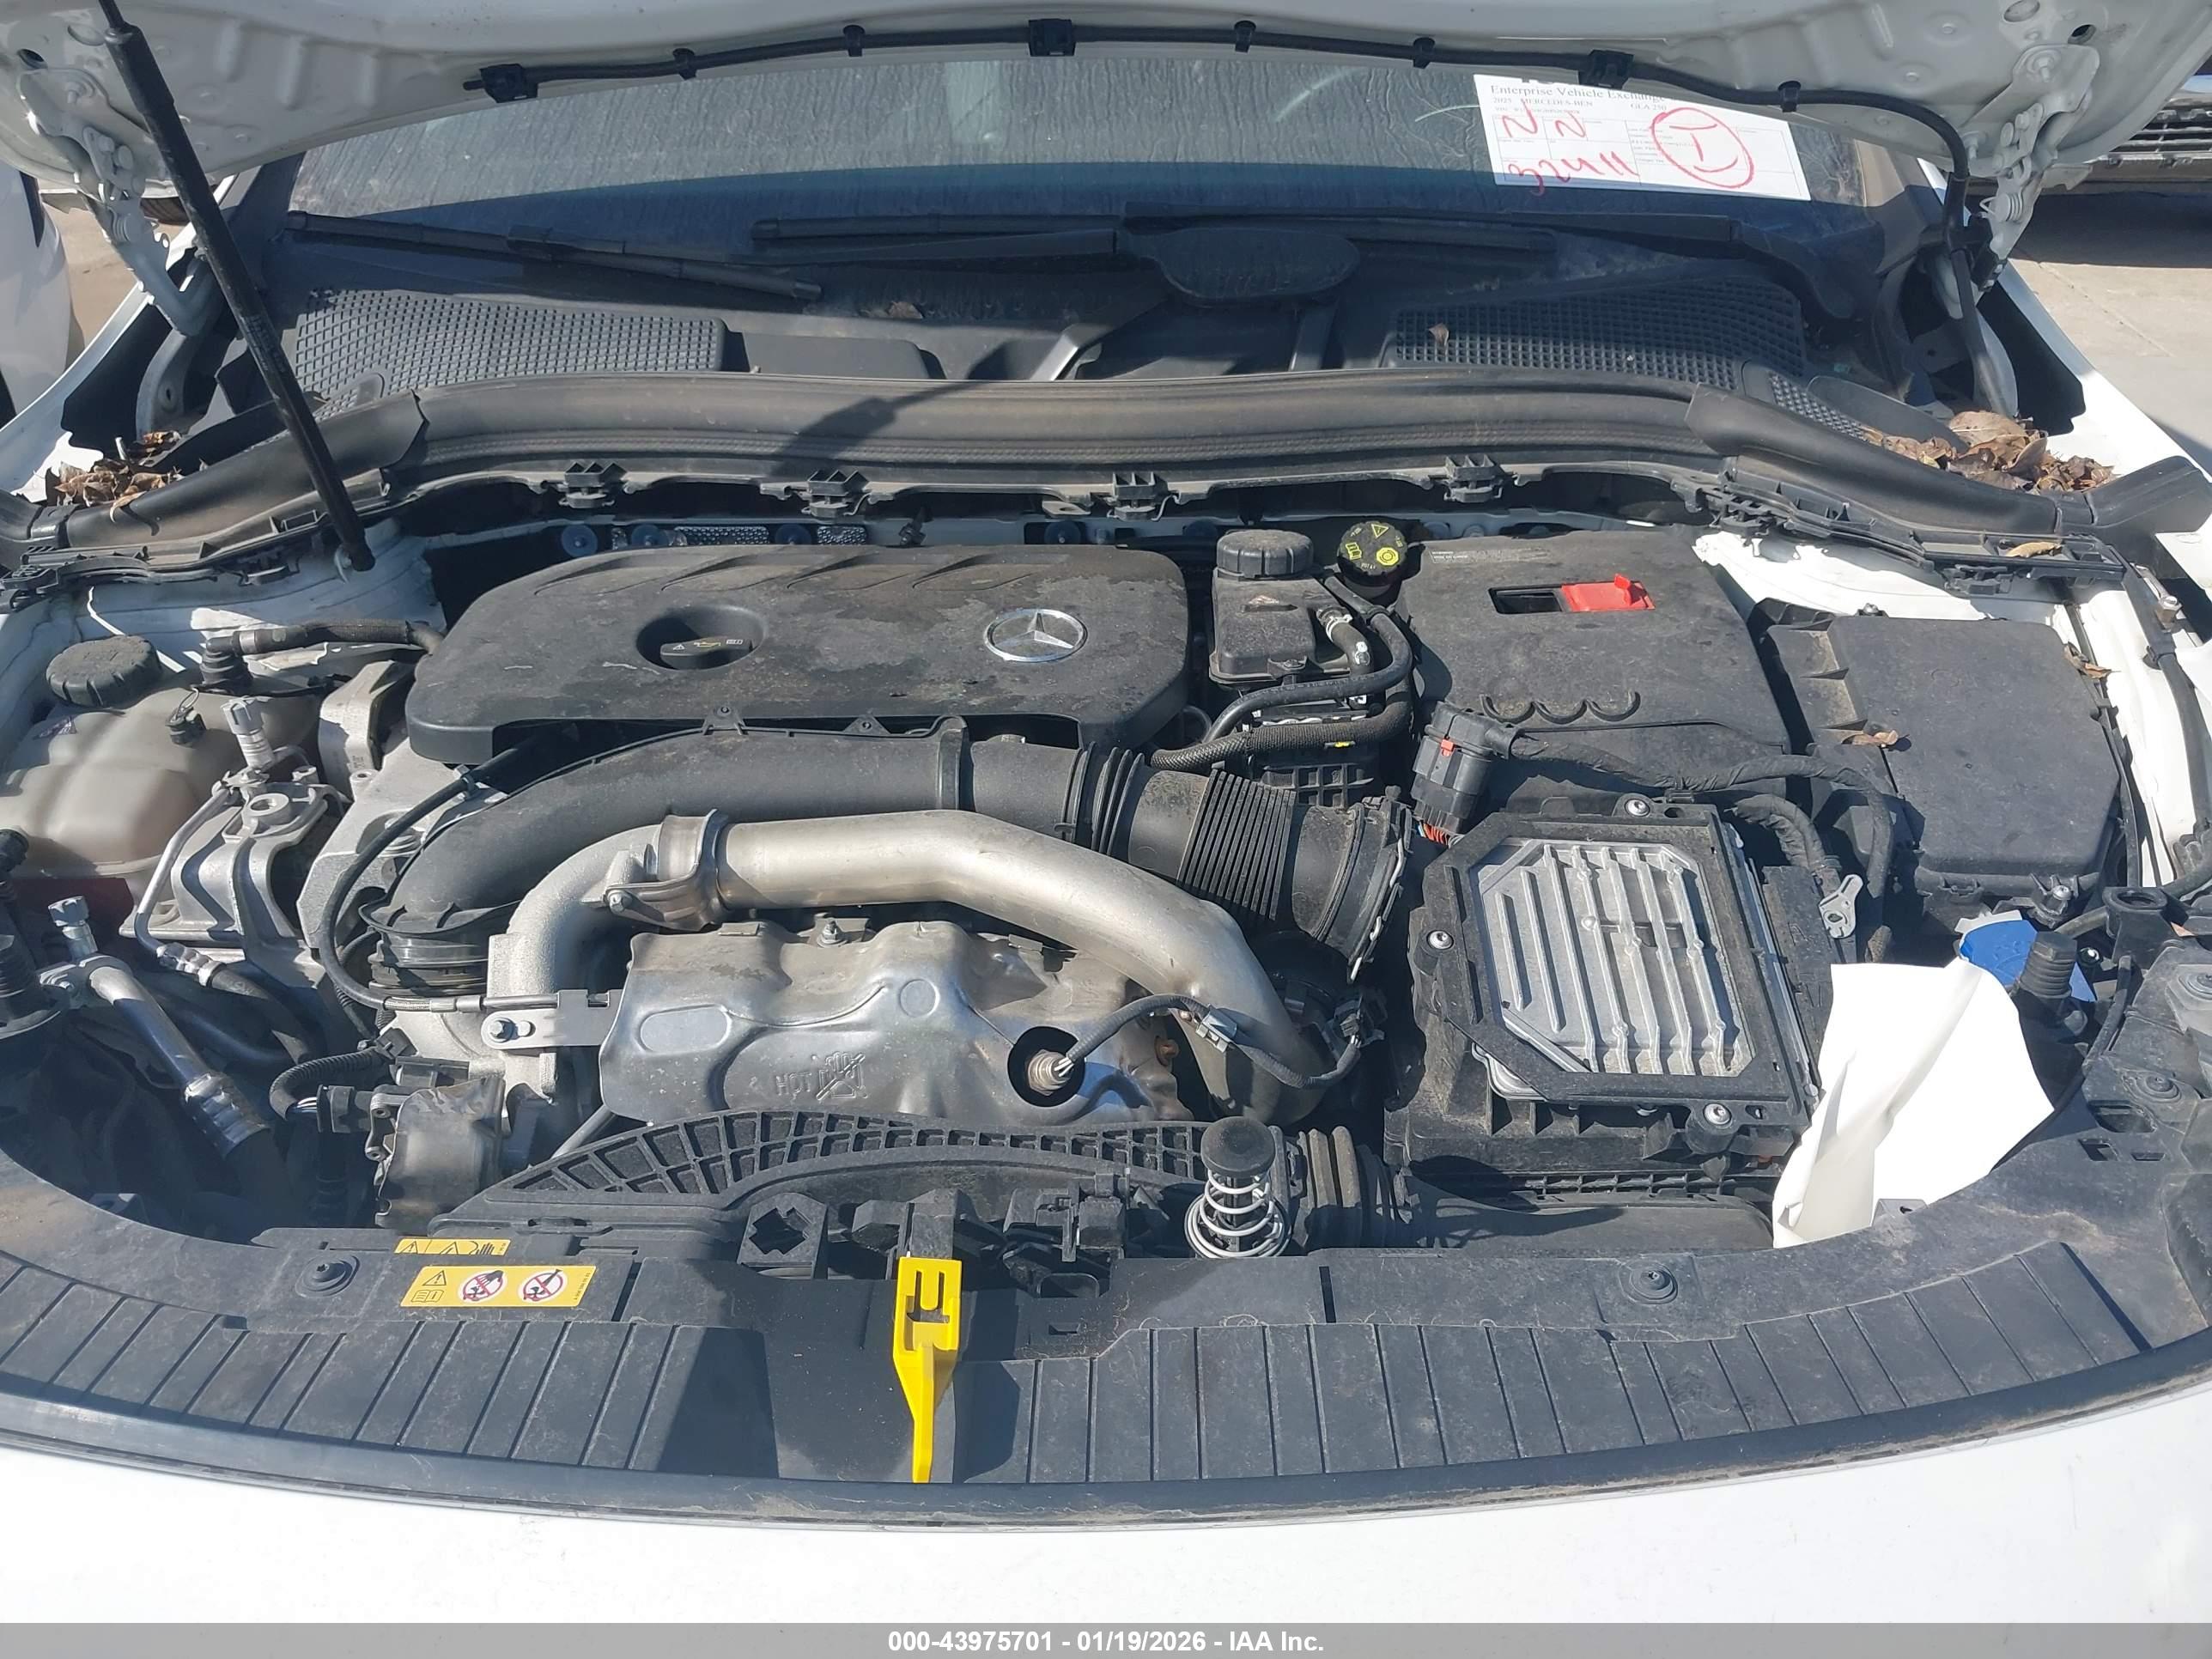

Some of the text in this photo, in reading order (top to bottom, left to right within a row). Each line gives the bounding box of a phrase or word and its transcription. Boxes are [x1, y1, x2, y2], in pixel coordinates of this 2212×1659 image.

[1491, 85, 1553, 96] Enterprise
[1556, 87, 1604, 98] Vehicle
[775, 1073, 812, 1097] HOT
